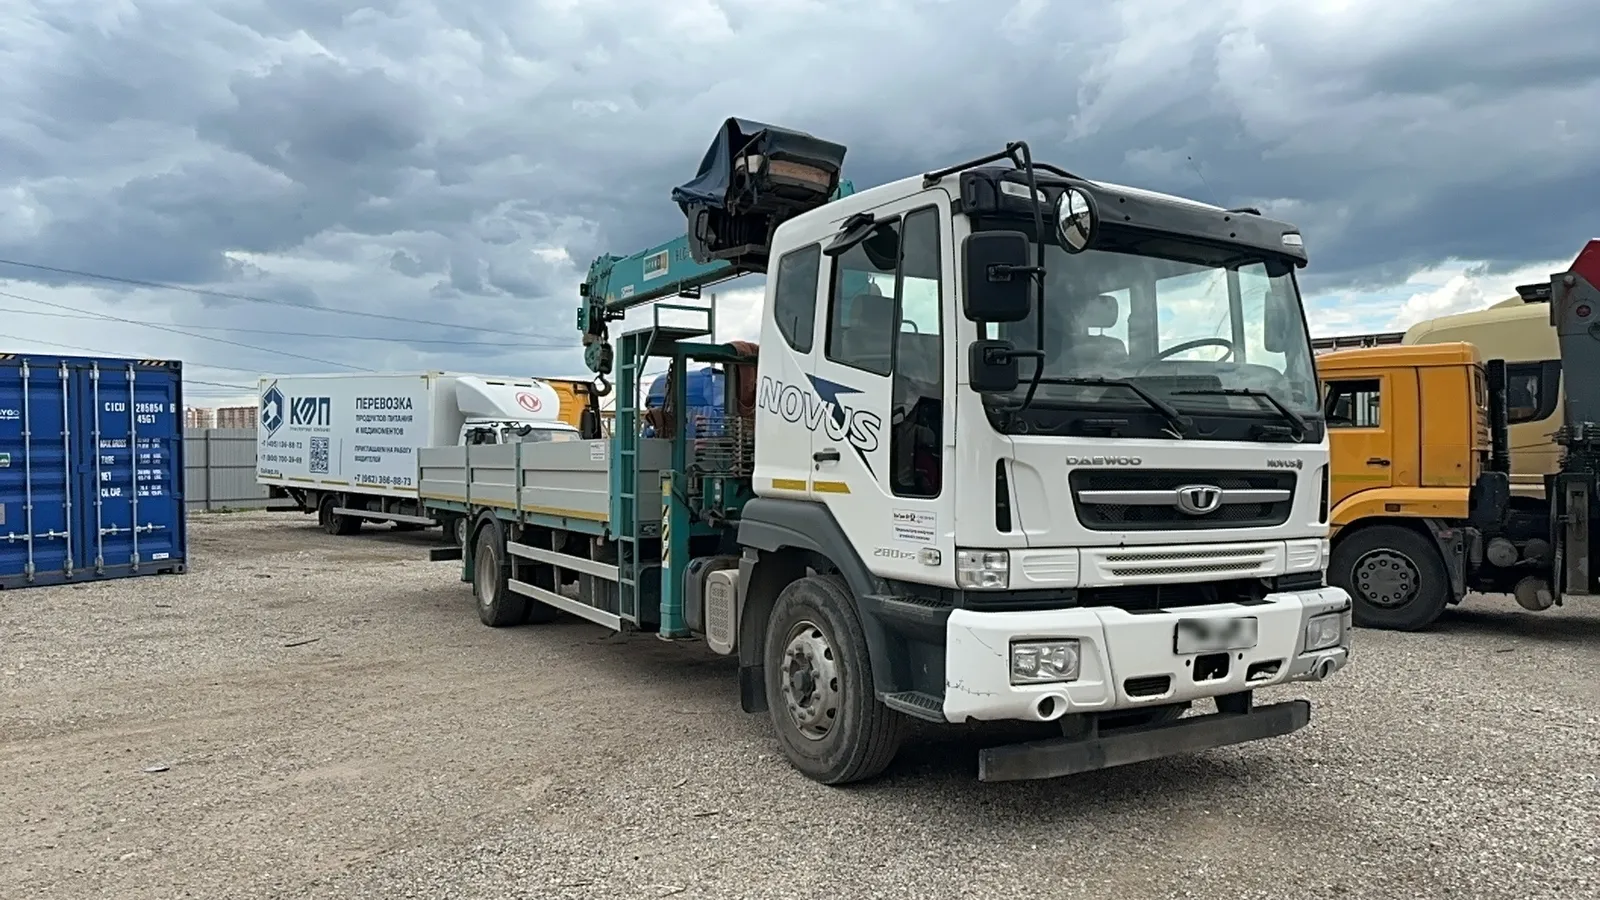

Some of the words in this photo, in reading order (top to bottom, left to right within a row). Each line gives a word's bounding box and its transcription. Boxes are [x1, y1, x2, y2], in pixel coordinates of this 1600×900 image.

[105, 402, 126, 412] CICU
[355, 397, 413, 410] ПЕРЕВОЗКА
[759, 376, 882, 452] NOVUS
[137, 415, 156, 424] 45G1
[1066, 456, 1142, 466] DAEWOO
